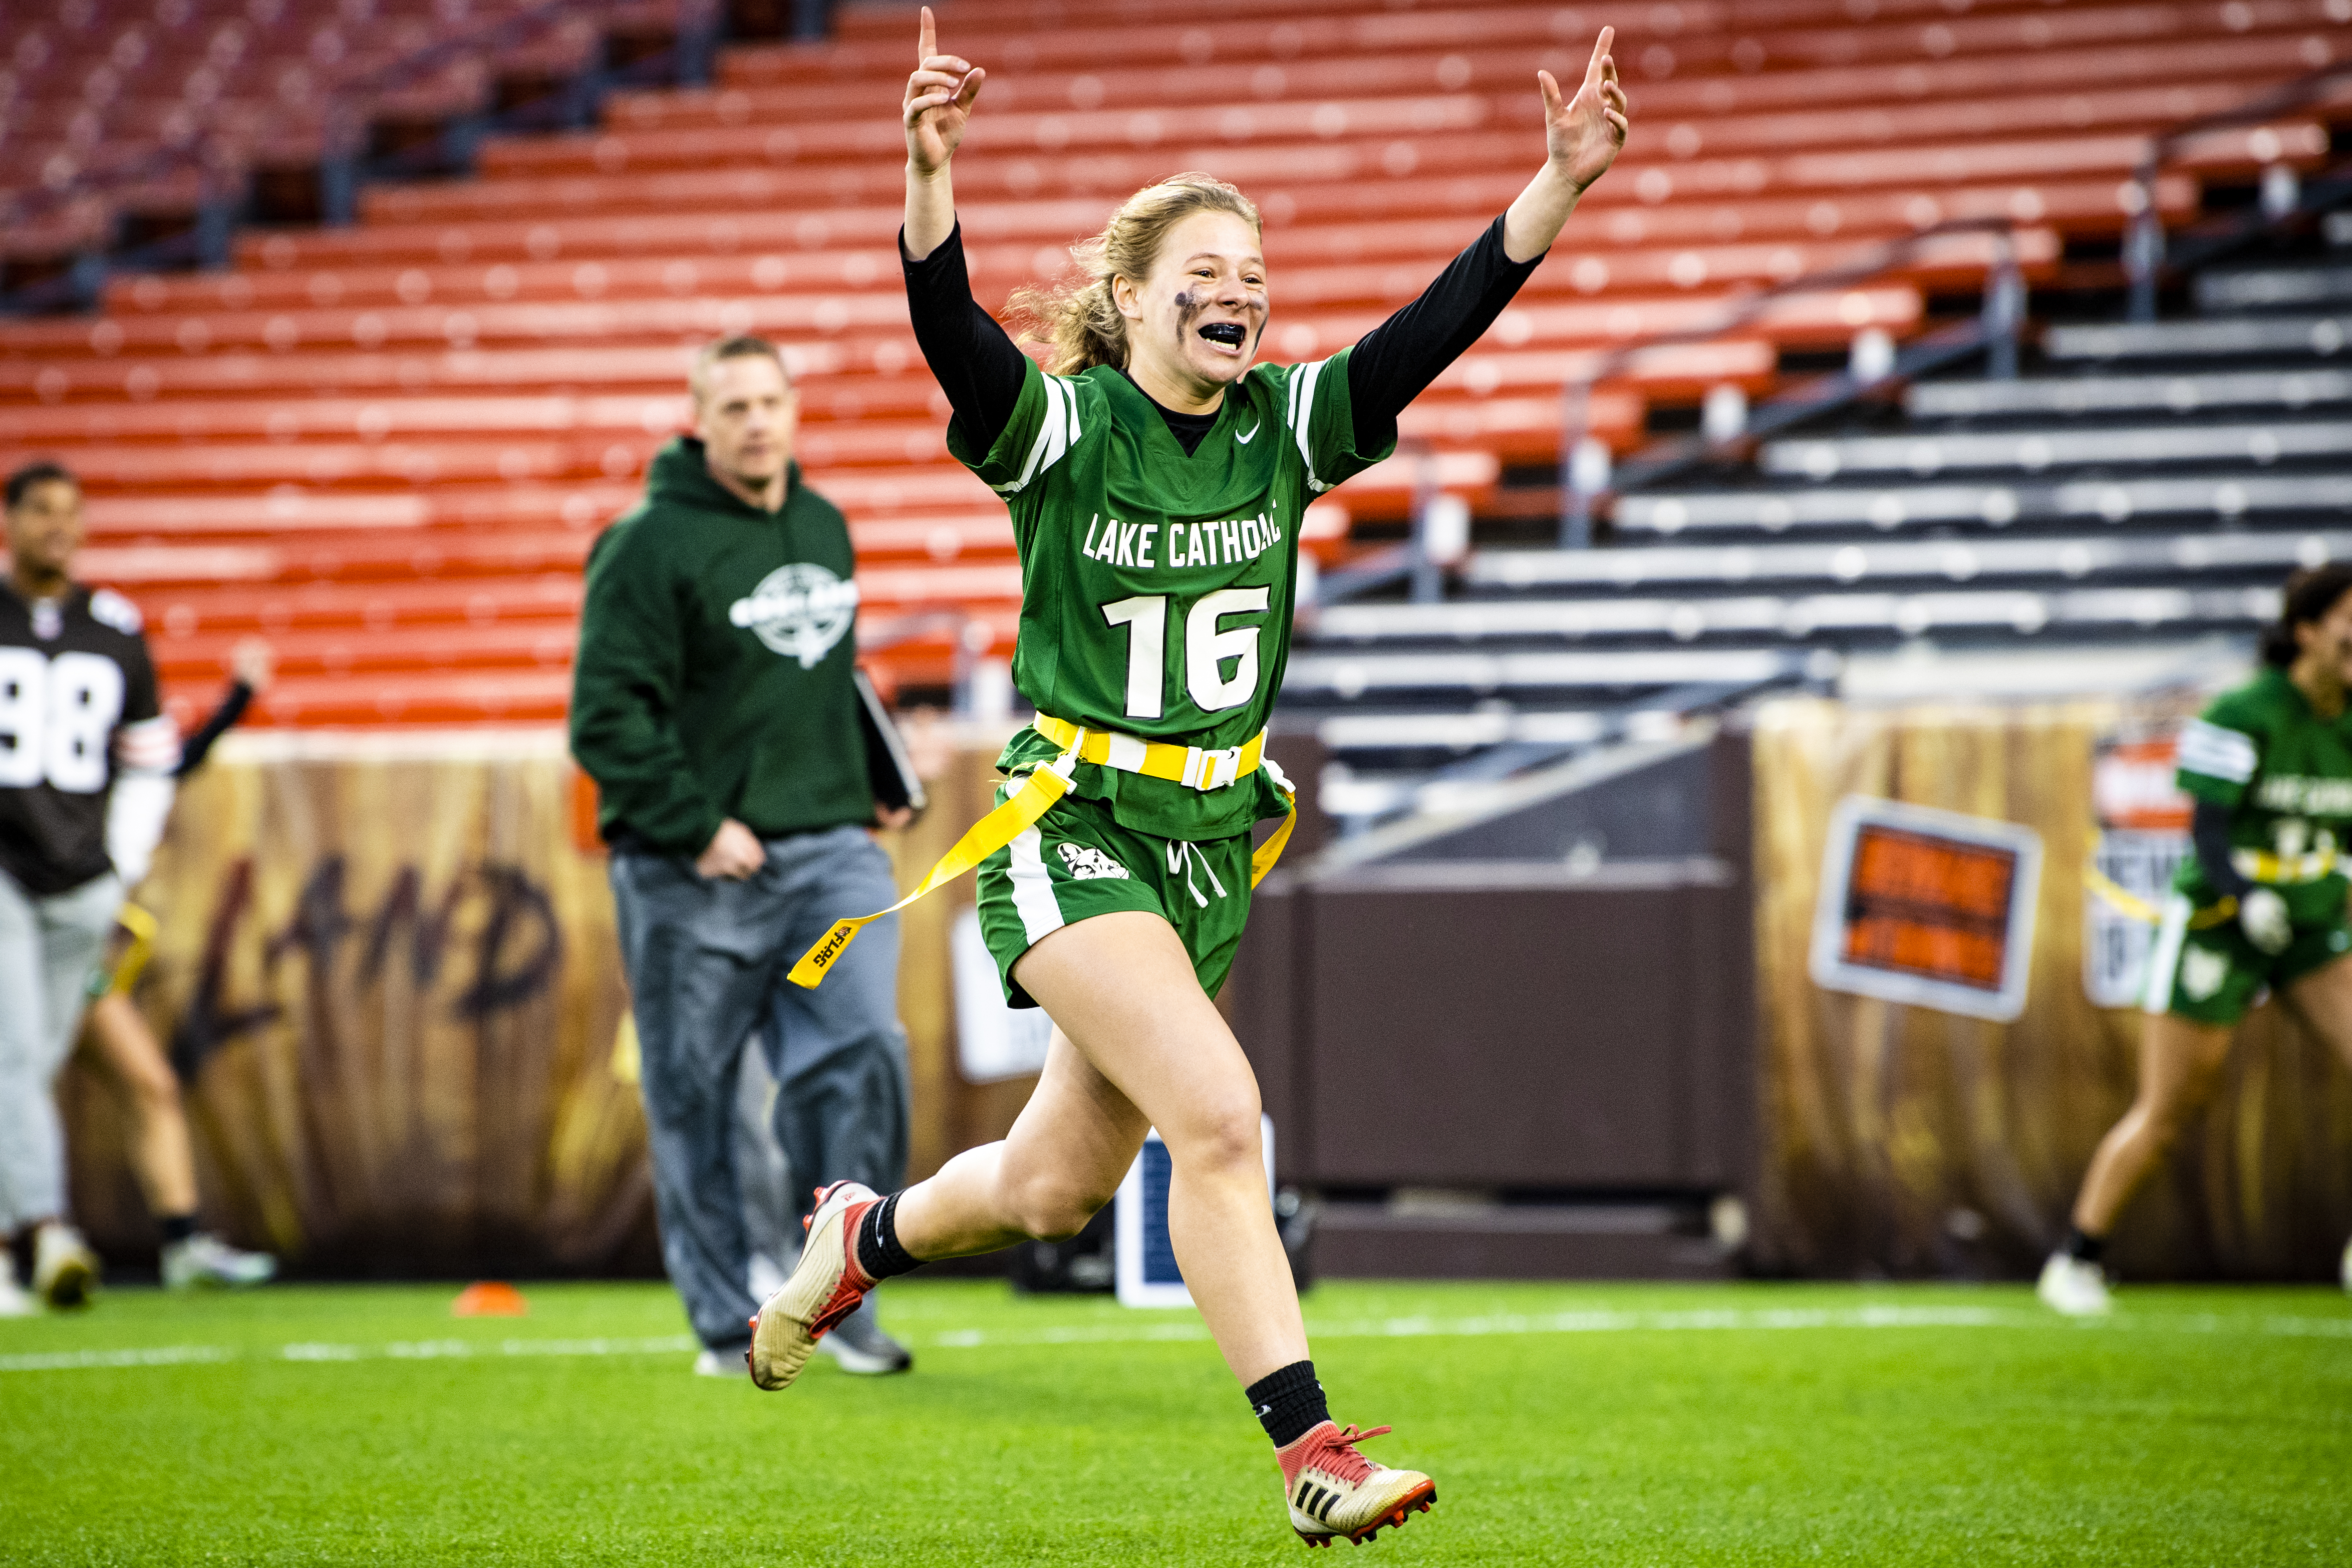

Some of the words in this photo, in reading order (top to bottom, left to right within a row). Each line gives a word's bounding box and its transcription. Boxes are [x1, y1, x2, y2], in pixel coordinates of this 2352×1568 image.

[1082, 513, 1158, 568] LAKE
[1097, 583, 1272, 720] 16
[813, 932, 845, 968] FLAG
